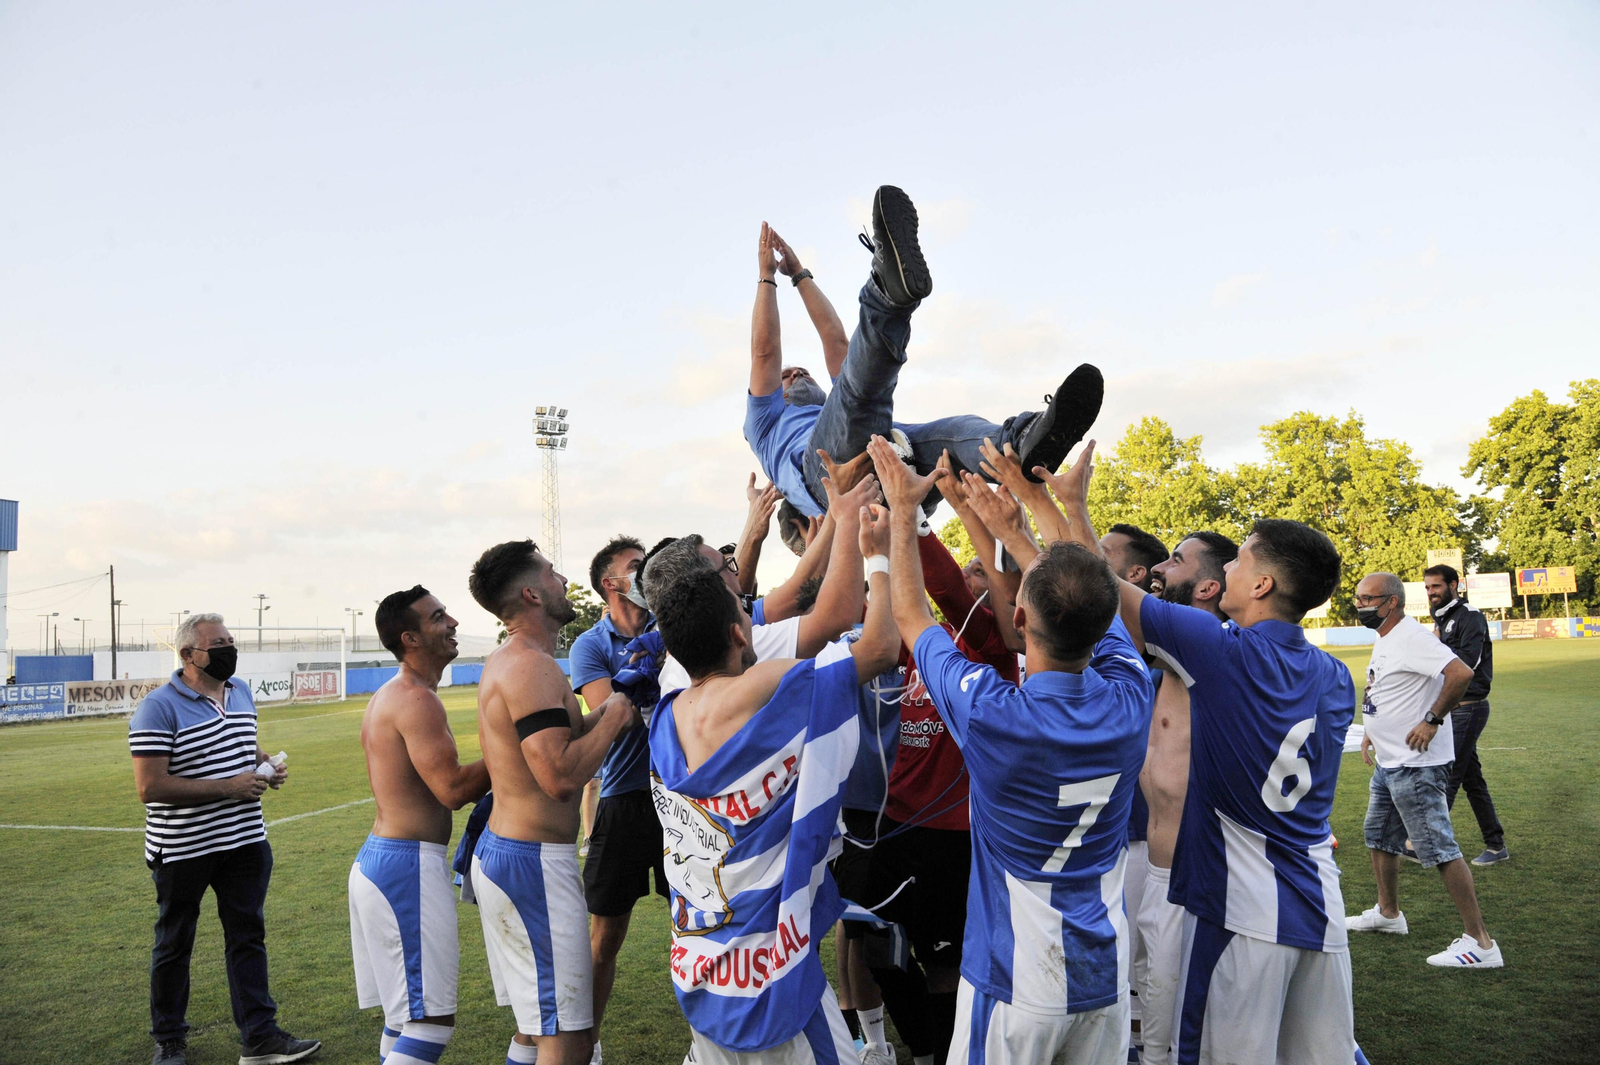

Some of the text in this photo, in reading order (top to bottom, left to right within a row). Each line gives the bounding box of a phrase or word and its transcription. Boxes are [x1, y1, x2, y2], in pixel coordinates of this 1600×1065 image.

[68, 682, 125, 704] MESÓN
[255, 680, 289, 696] Arcos
[297, 675, 320, 692] PSOE
[1261, 714, 1317, 812] 6
[1040, 772, 1122, 873] 7
